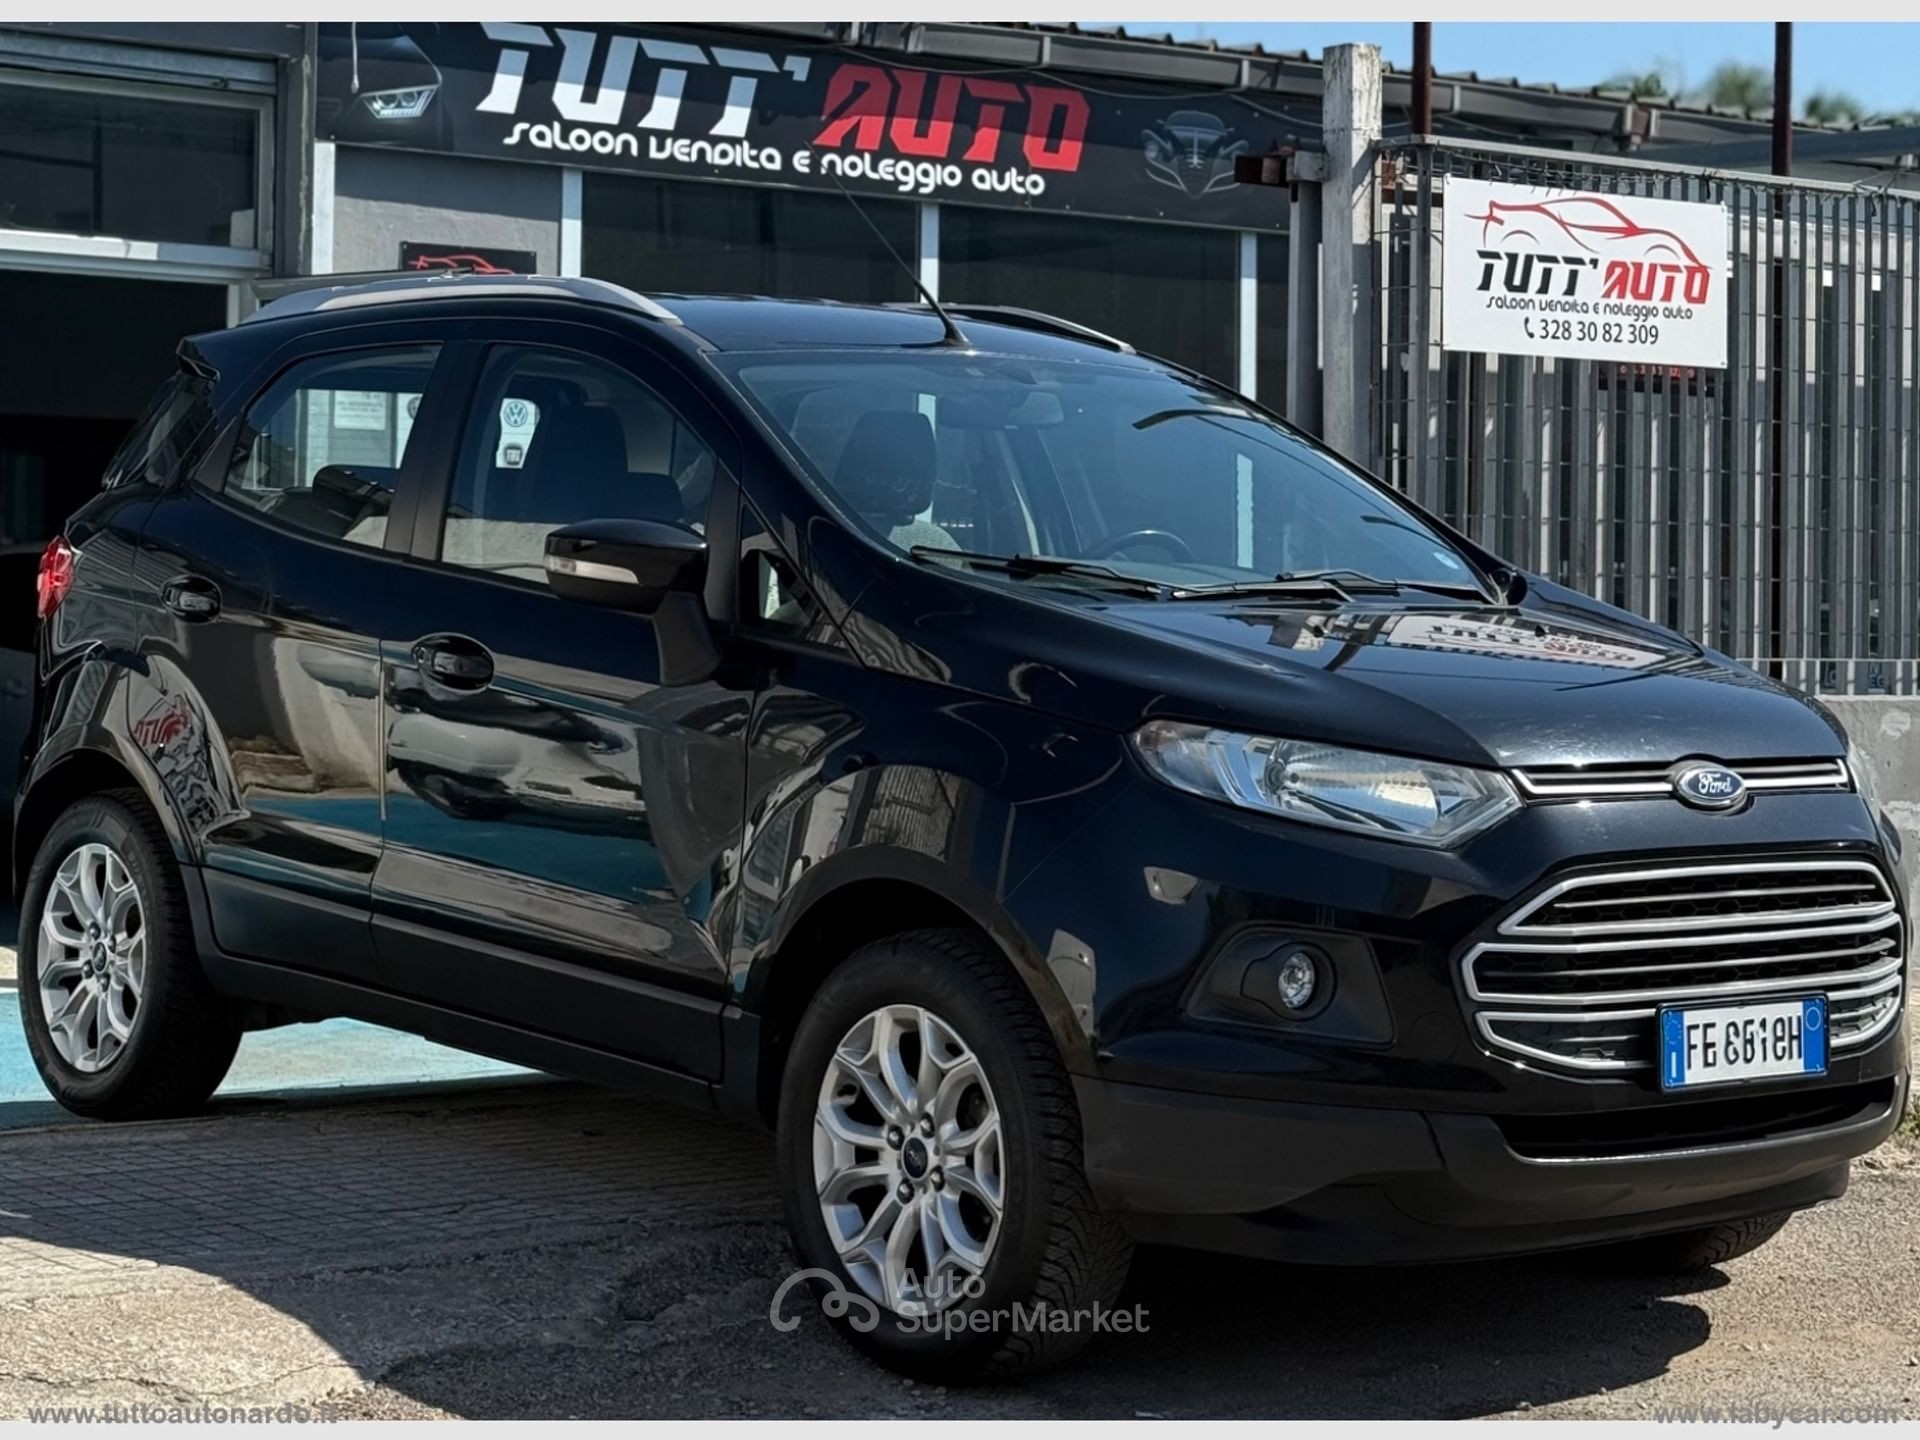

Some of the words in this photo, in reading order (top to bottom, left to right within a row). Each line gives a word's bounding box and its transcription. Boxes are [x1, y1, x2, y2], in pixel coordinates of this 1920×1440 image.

[475, 22, 812, 138] TUTT'
[812, 63, 1091, 172] AUTO
[970, 166, 1046, 196] auto
[1476, 249, 1599, 297] TUTT'
[1601, 260, 1711, 305] AUTO
[1662, 305, 1693, 320] auto
[1539, 318, 1572, 341] 328
[1576, 321, 1598, 342] 30
[1602, 322, 1624, 344] 82
[1627, 323, 1660, 345] 309
[1698, 772, 1733, 794] Ford
